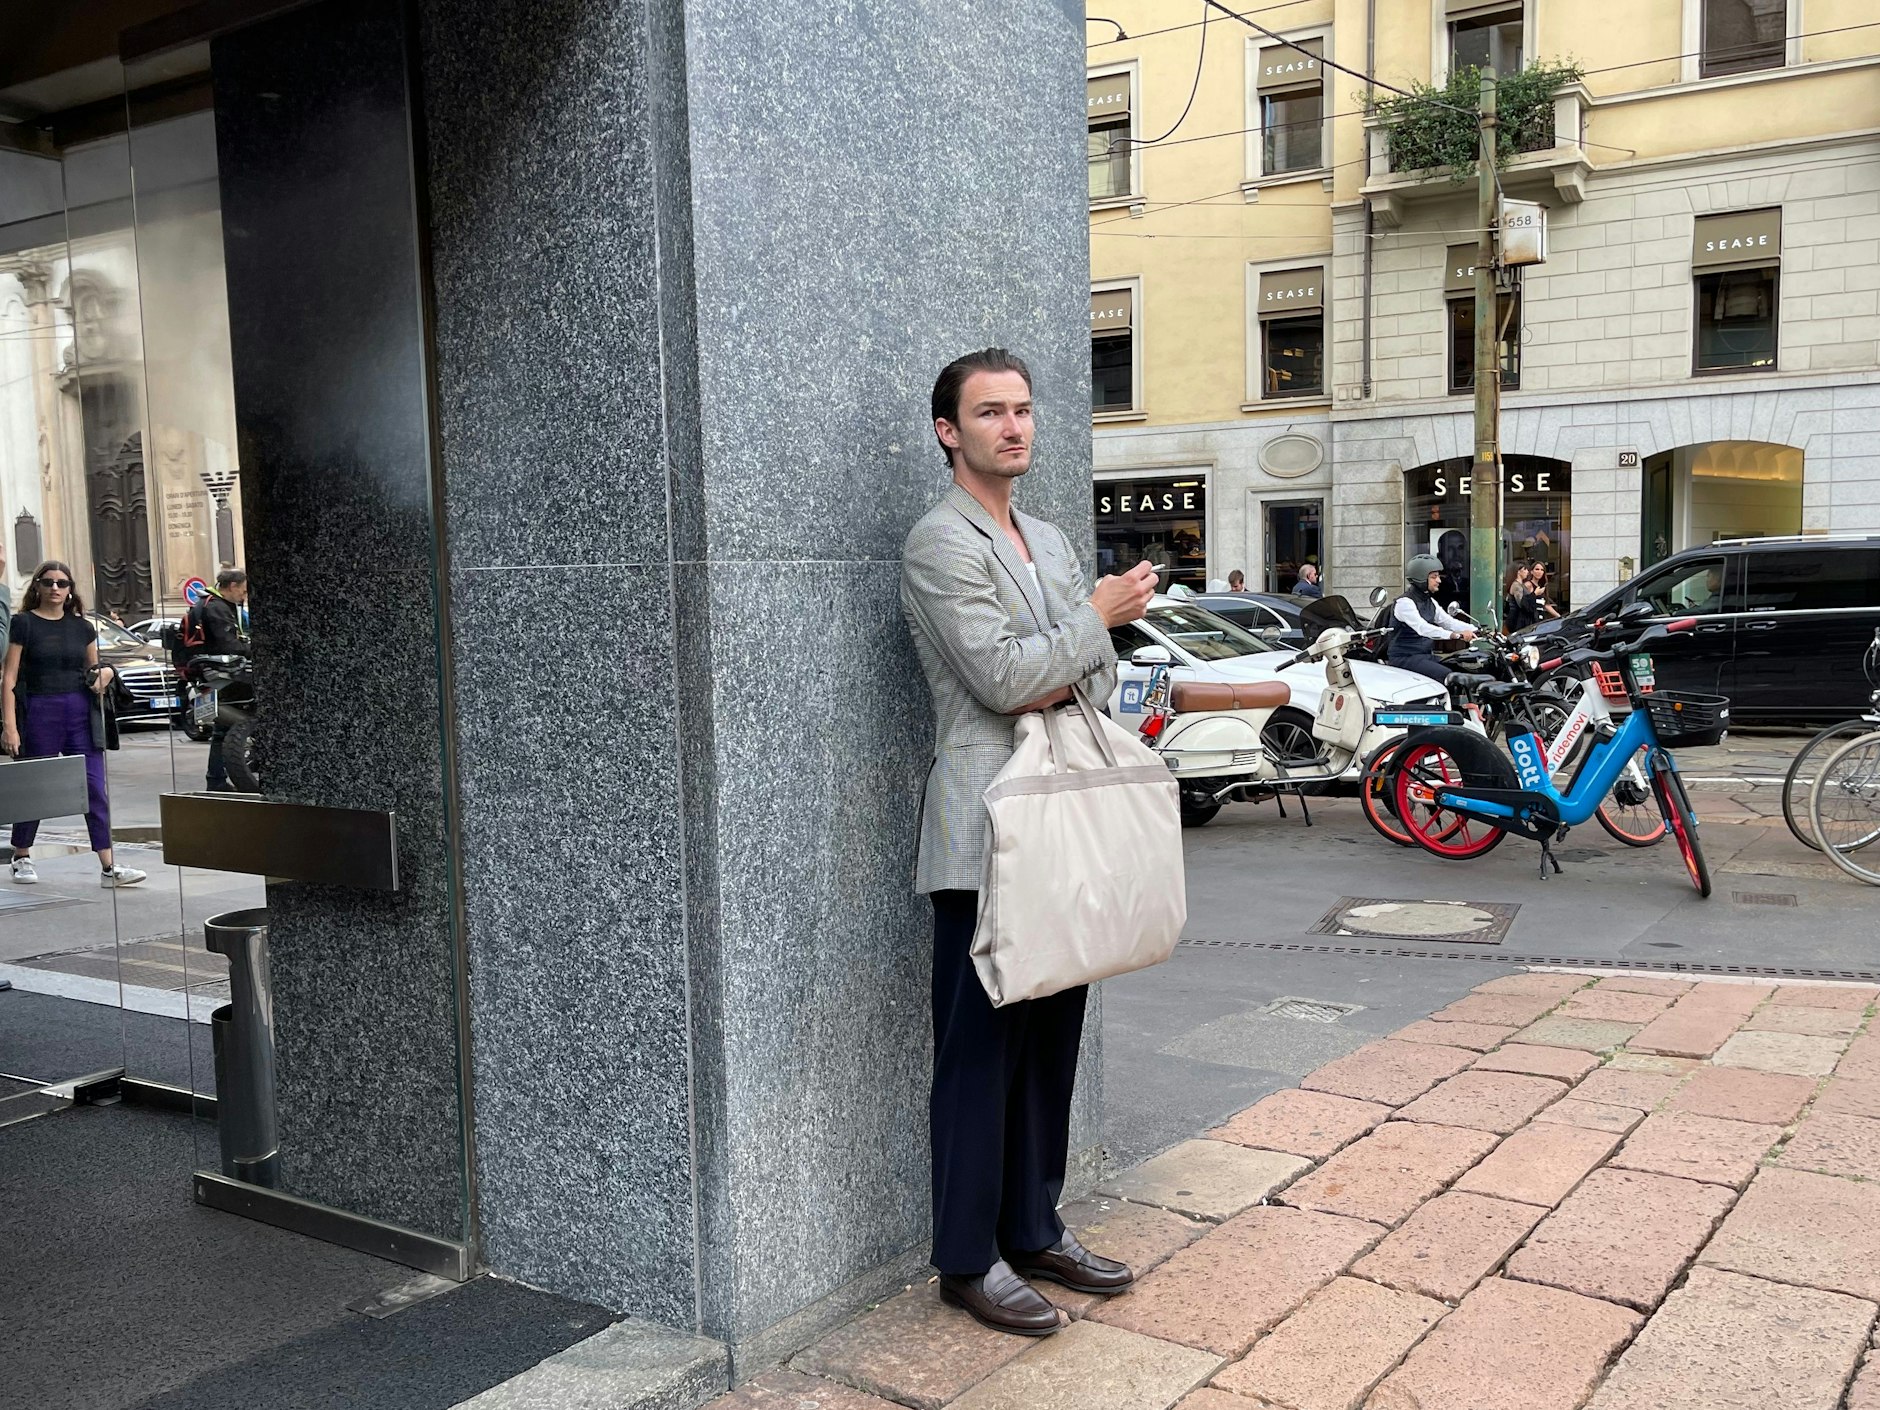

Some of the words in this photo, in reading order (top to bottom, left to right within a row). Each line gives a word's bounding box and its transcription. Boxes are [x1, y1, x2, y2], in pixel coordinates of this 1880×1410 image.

[1266, 59, 1314, 75] SEASE
[1088, 93, 1122, 106] EASE
[1508, 215, 1532, 228] 558
[1706, 235, 1767, 251] SEASE
[1266, 287, 1315, 301] SEASE
[1090, 308, 1124, 320] EASE
[1621, 454, 1636, 465] 20
[1434, 473, 1551, 496] SESE
[1100, 492, 1195, 514] SEASE
[1394, 714, 1430, 724] electric
[1553, 711, 1588, 763] ridemovi
[1513, 739, 1541, 788] dott
